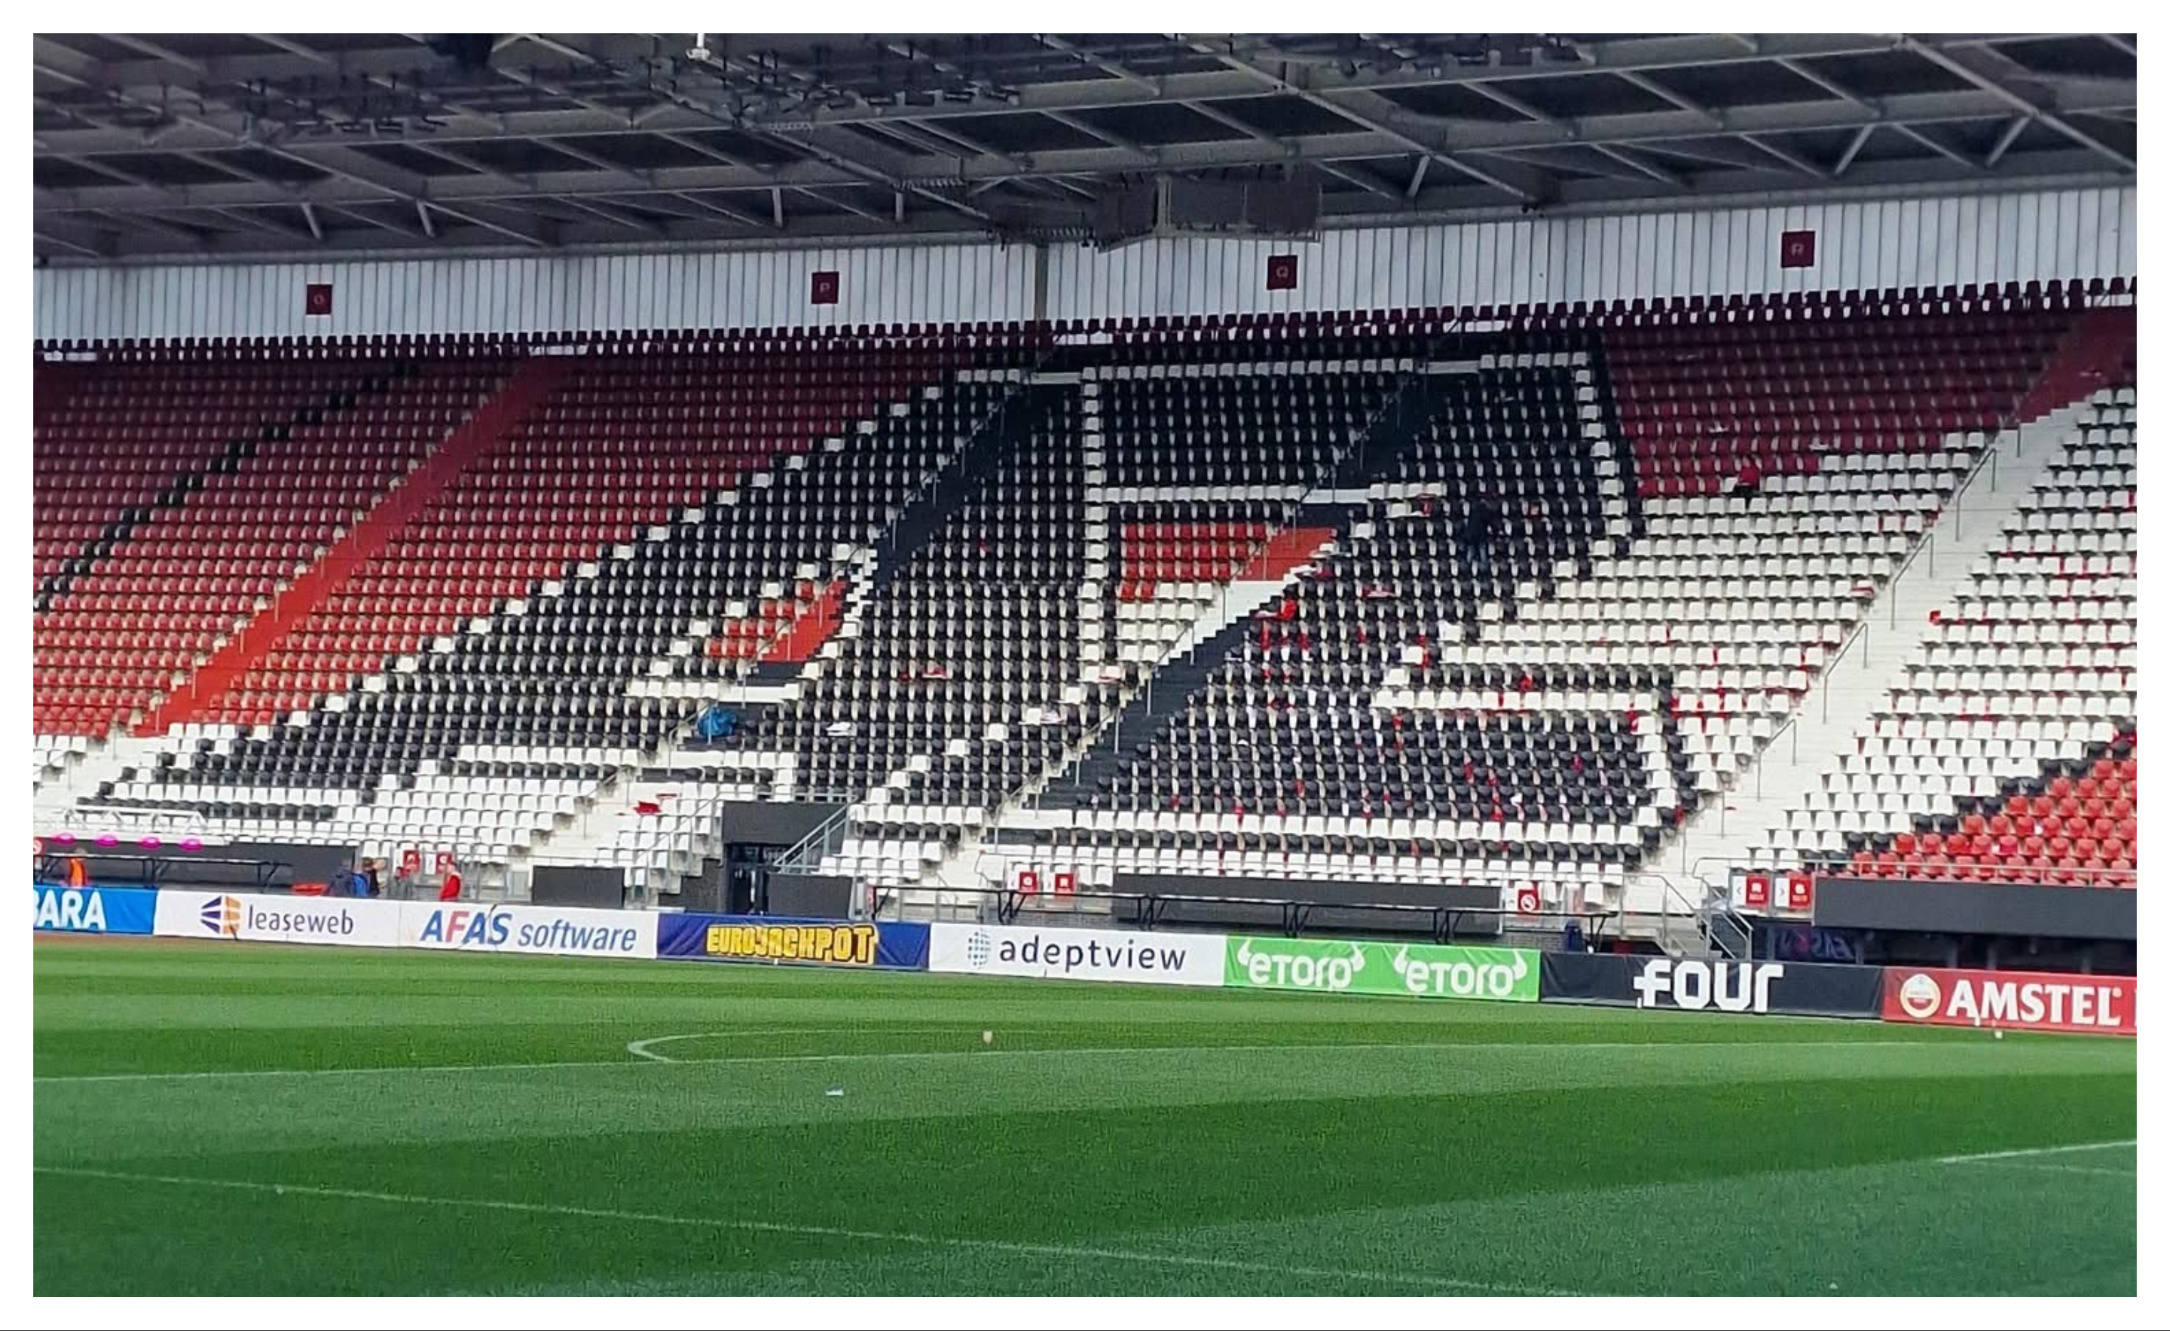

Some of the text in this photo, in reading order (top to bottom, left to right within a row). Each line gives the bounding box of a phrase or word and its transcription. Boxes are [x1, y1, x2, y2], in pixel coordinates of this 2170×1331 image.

[247, 904, 354, 935] leaseweb
[420, 909, 637, 951] AFAS software
[706, 923, 879, 965] EUROJACKPOT
[1000, 934, 1186, 973] adeptview
[1633, 959, 1784, 1013] four
[1946, 979, 2121, 1027] AMSTEL
